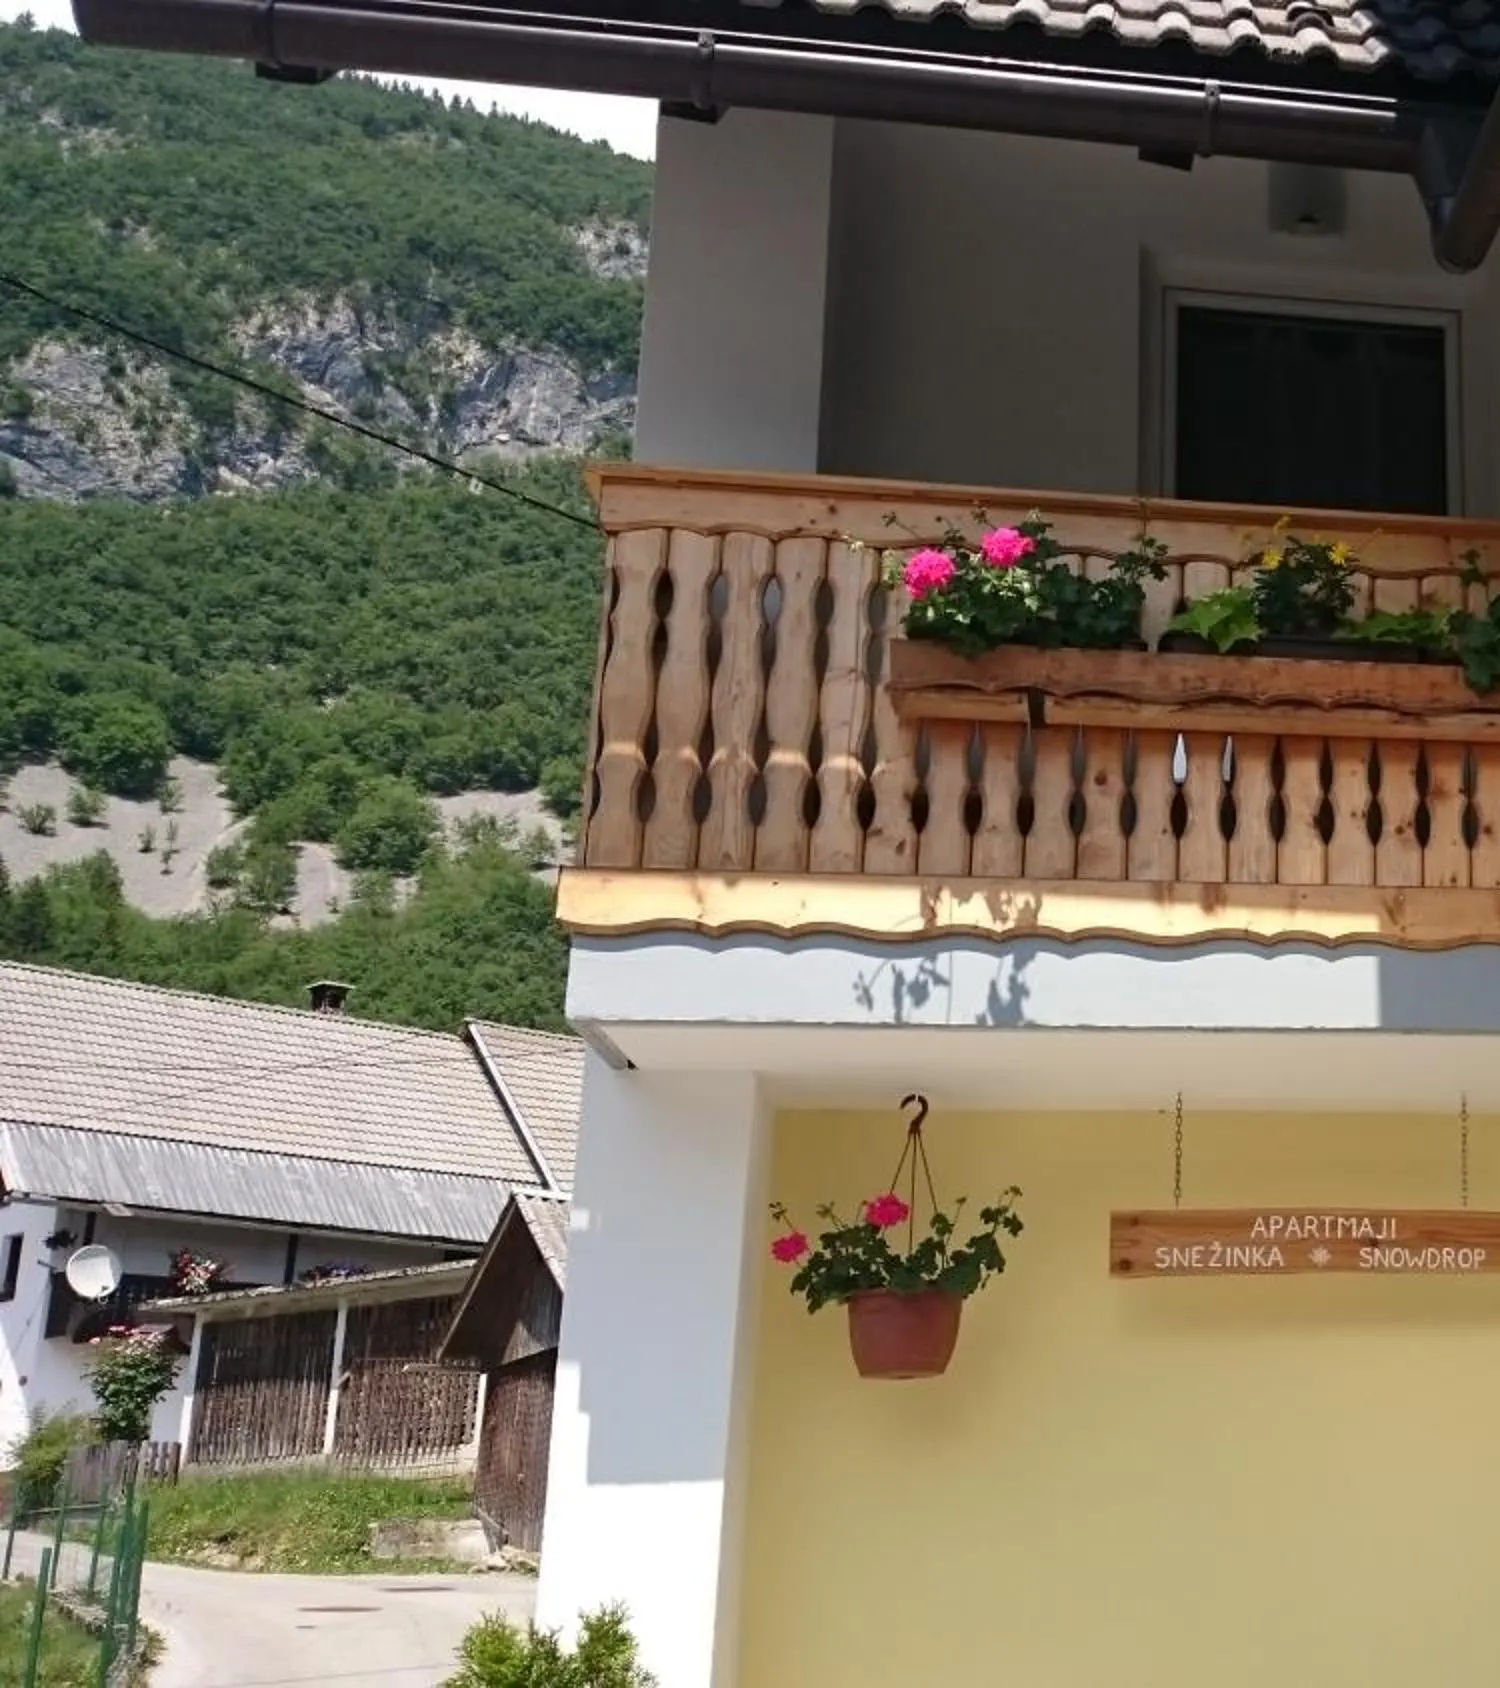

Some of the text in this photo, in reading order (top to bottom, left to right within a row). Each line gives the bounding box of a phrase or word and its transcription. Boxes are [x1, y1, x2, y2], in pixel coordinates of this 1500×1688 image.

[1250, 1214, 1400, 1241] APARTMAJI
[1154, 1242, 1488, 1270] SNEŽINKA SNOWDROP
